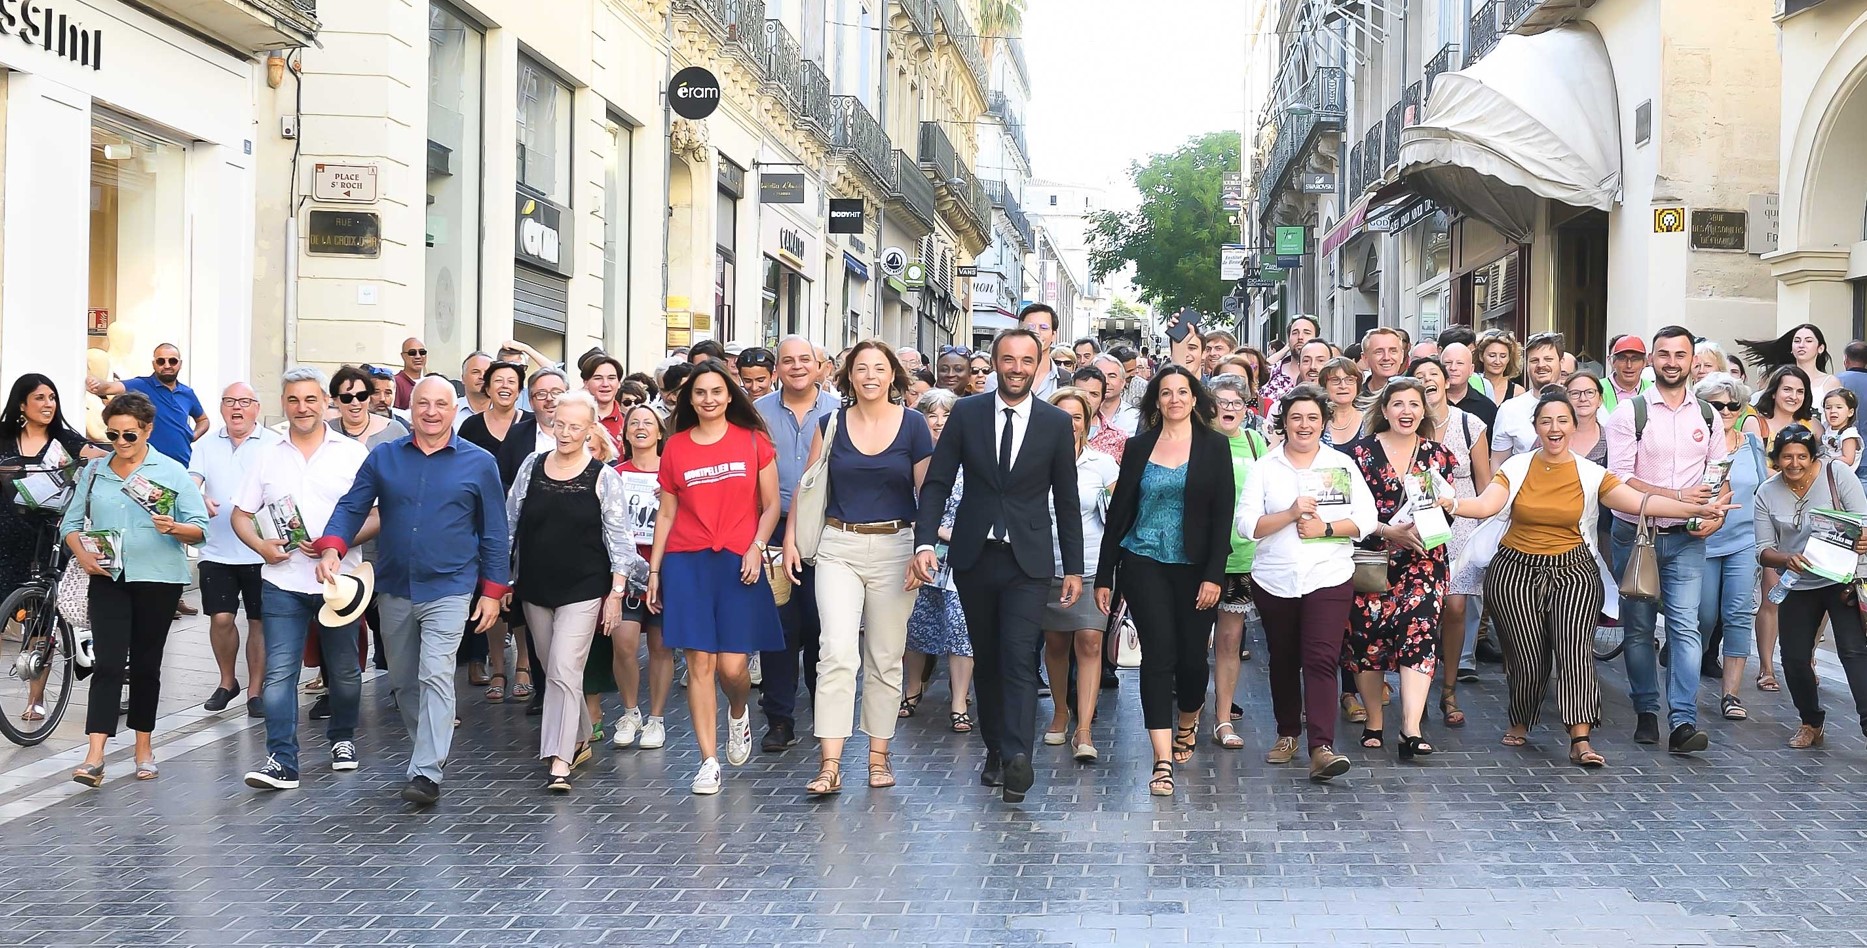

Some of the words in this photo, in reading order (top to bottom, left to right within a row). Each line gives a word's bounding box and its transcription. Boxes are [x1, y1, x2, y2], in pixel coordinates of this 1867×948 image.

[677, 81, 719, 99] éram
[335, 173, 360, 181] PLACE
[830, 210, 861, 218] BODYHIT
[335, 217, 353, 227] RUE
[958, 267, 977, 276] VANS
